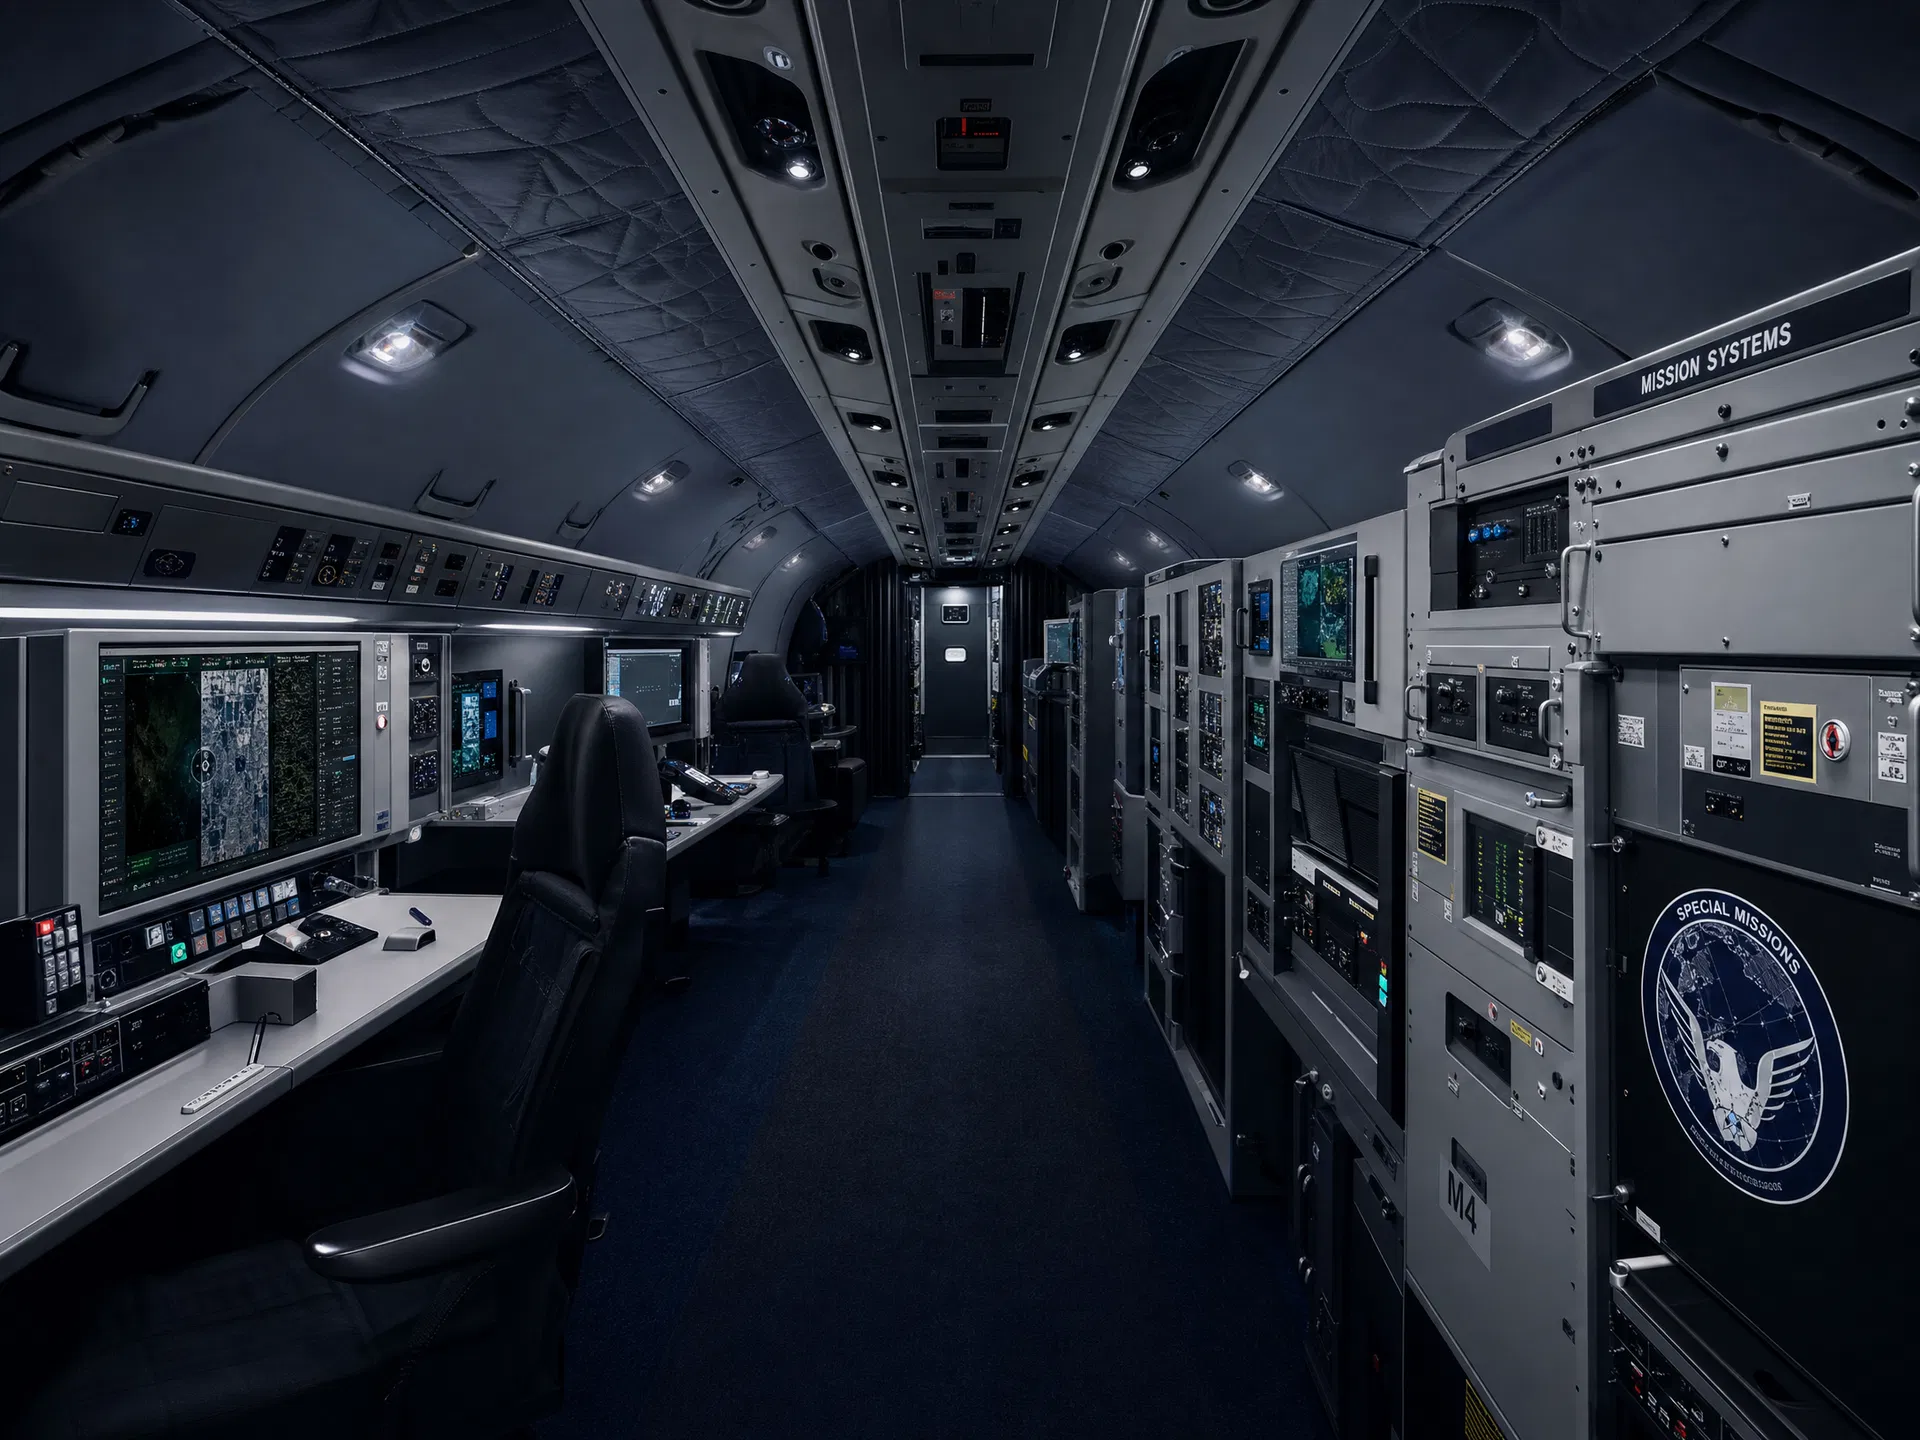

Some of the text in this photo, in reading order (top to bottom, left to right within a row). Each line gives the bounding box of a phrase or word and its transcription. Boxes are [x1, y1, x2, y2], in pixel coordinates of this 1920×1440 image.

[1641, 322, 1792, 395] MISSION SYSTEMS
[1676, 899, 1800, 975] SPECIAL MISSIONS
[1448, 1169, 1477, 1235] M4
